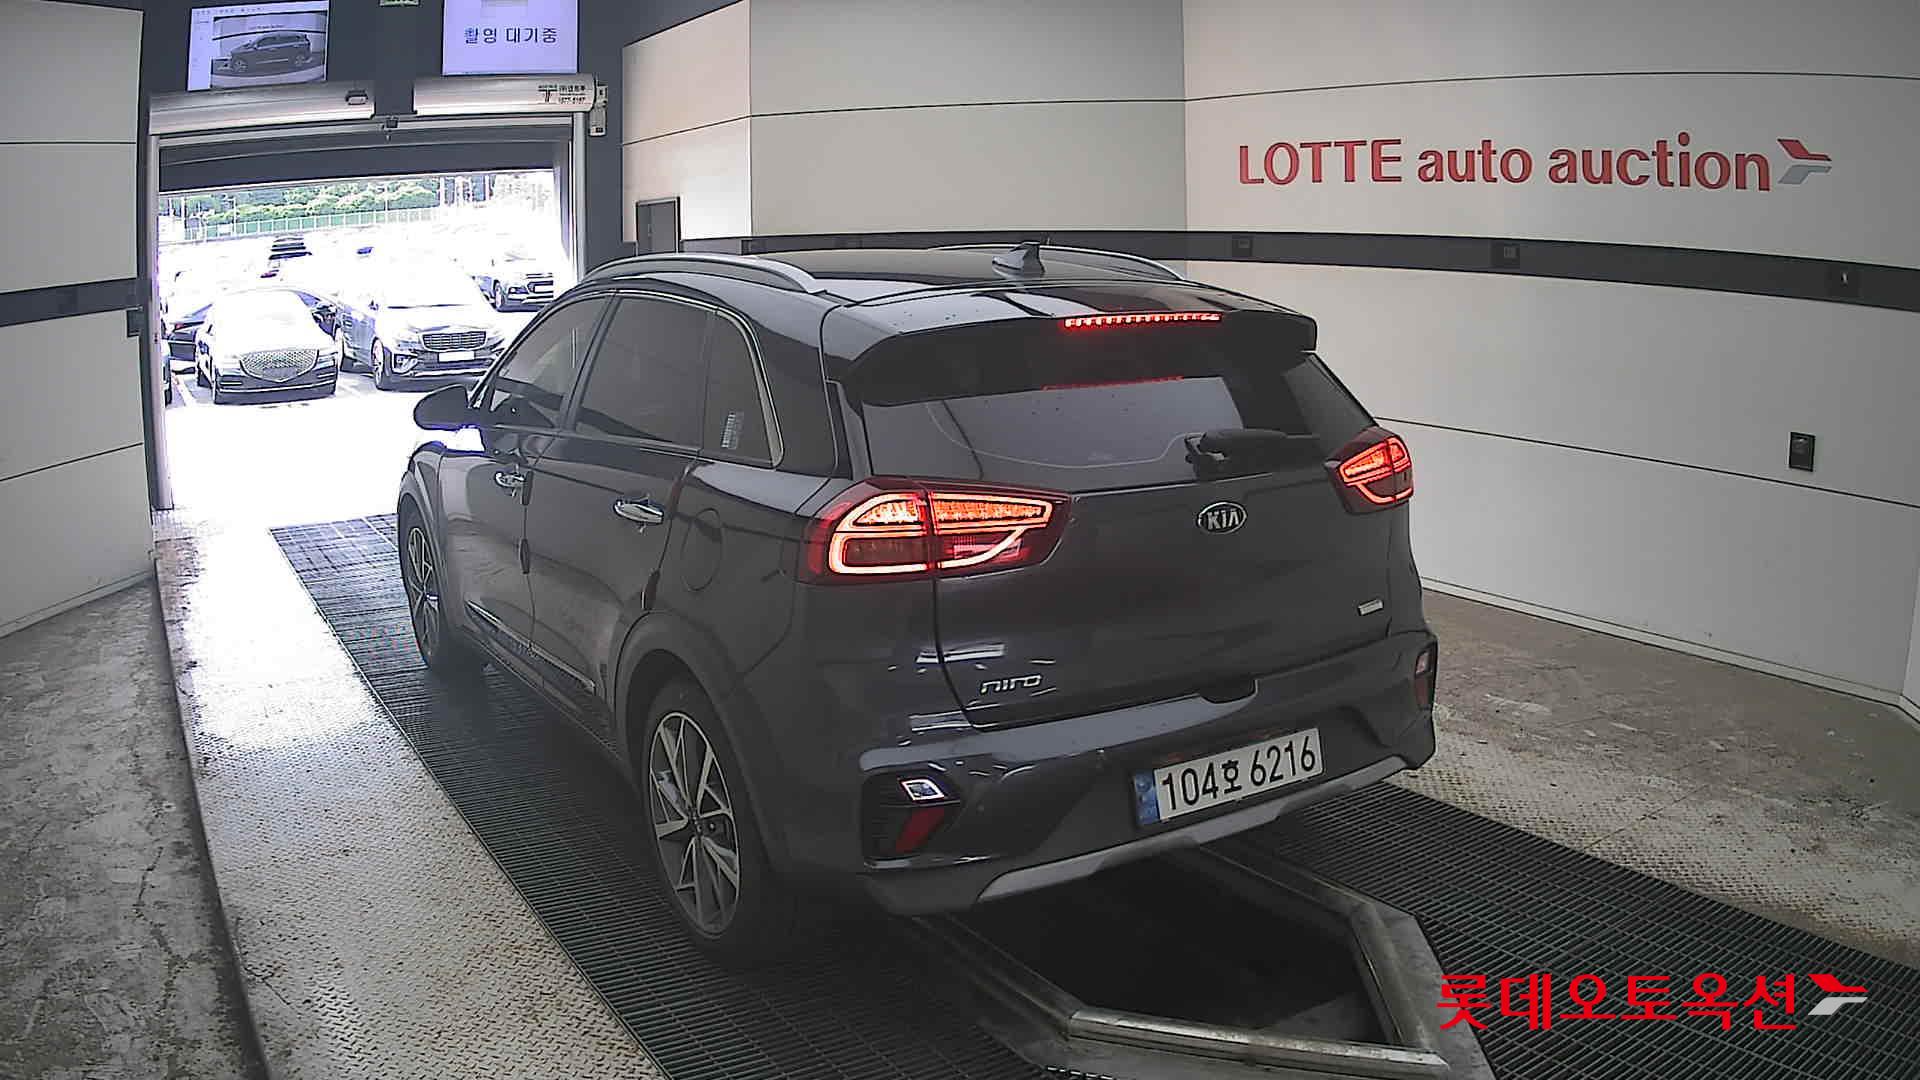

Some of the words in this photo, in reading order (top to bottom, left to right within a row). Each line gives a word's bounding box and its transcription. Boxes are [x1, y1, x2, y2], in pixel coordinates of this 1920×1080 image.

[505, 27, 558, 44] 대기중
[1239, 138, 1402, 185] LOTTE
[1417, 139, 1533, 184] auto
[1548, 131, 1771, 192] auction
[1206, 508, 1240, 530] KIA
[1161, 758, 1243, 811] 104호
[1250, 735, 1316, 787] 6216
